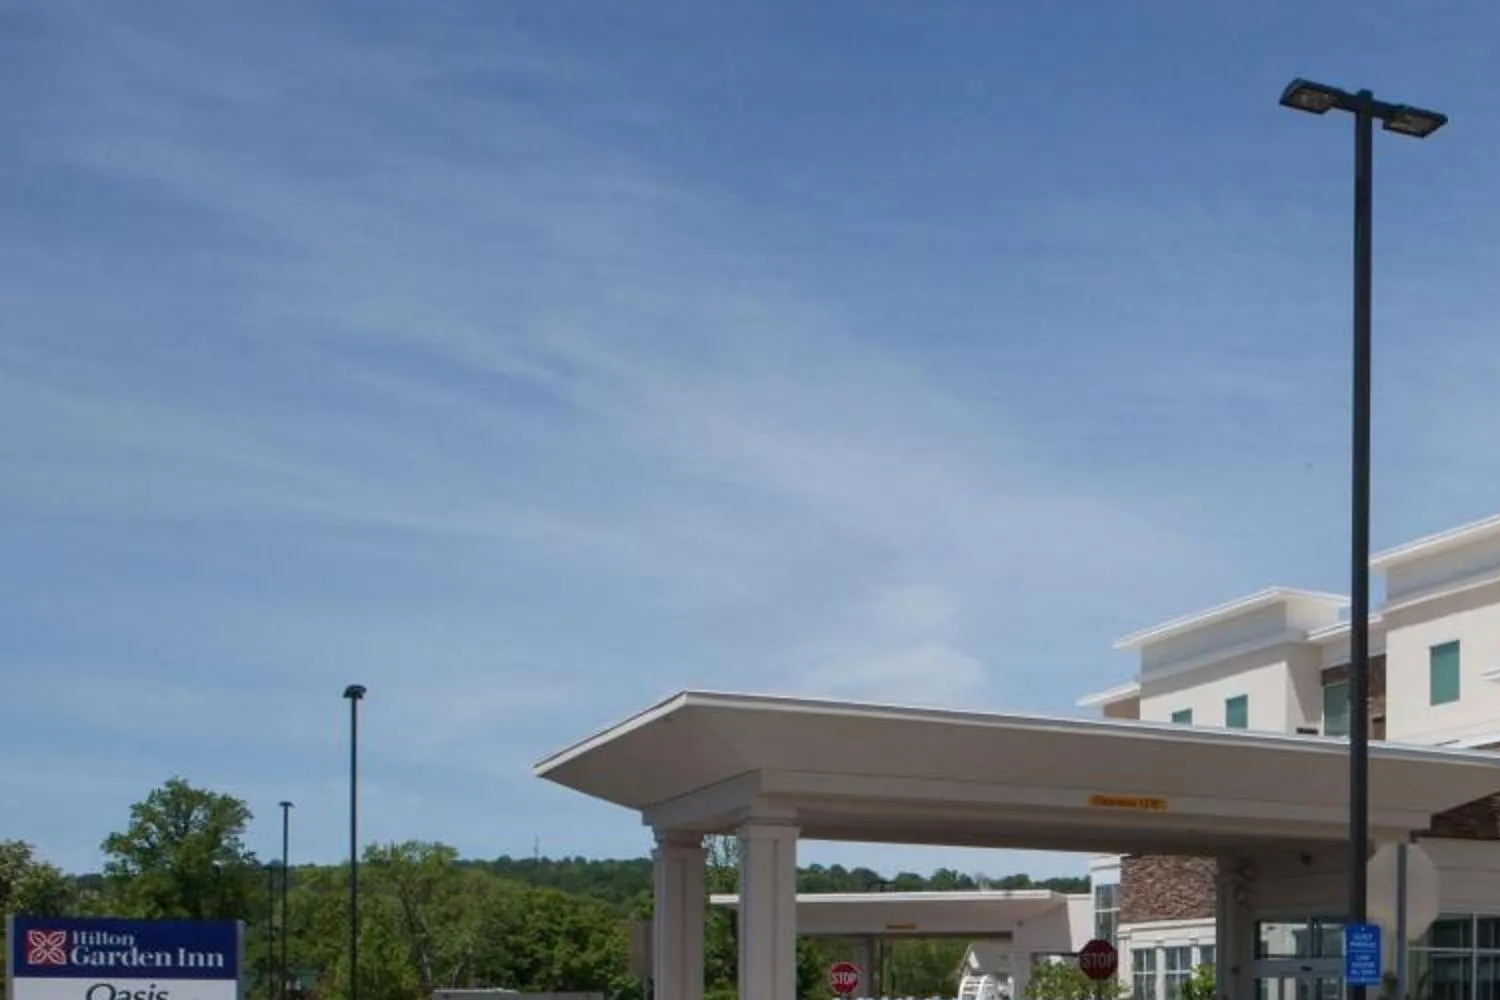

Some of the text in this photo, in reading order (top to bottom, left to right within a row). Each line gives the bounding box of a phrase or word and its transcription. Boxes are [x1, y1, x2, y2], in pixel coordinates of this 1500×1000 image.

[72, 930, 135, 946] Hilton
[70, 946, 224, 967] Garden Inn
[832, 971, 857, 985] STOP
